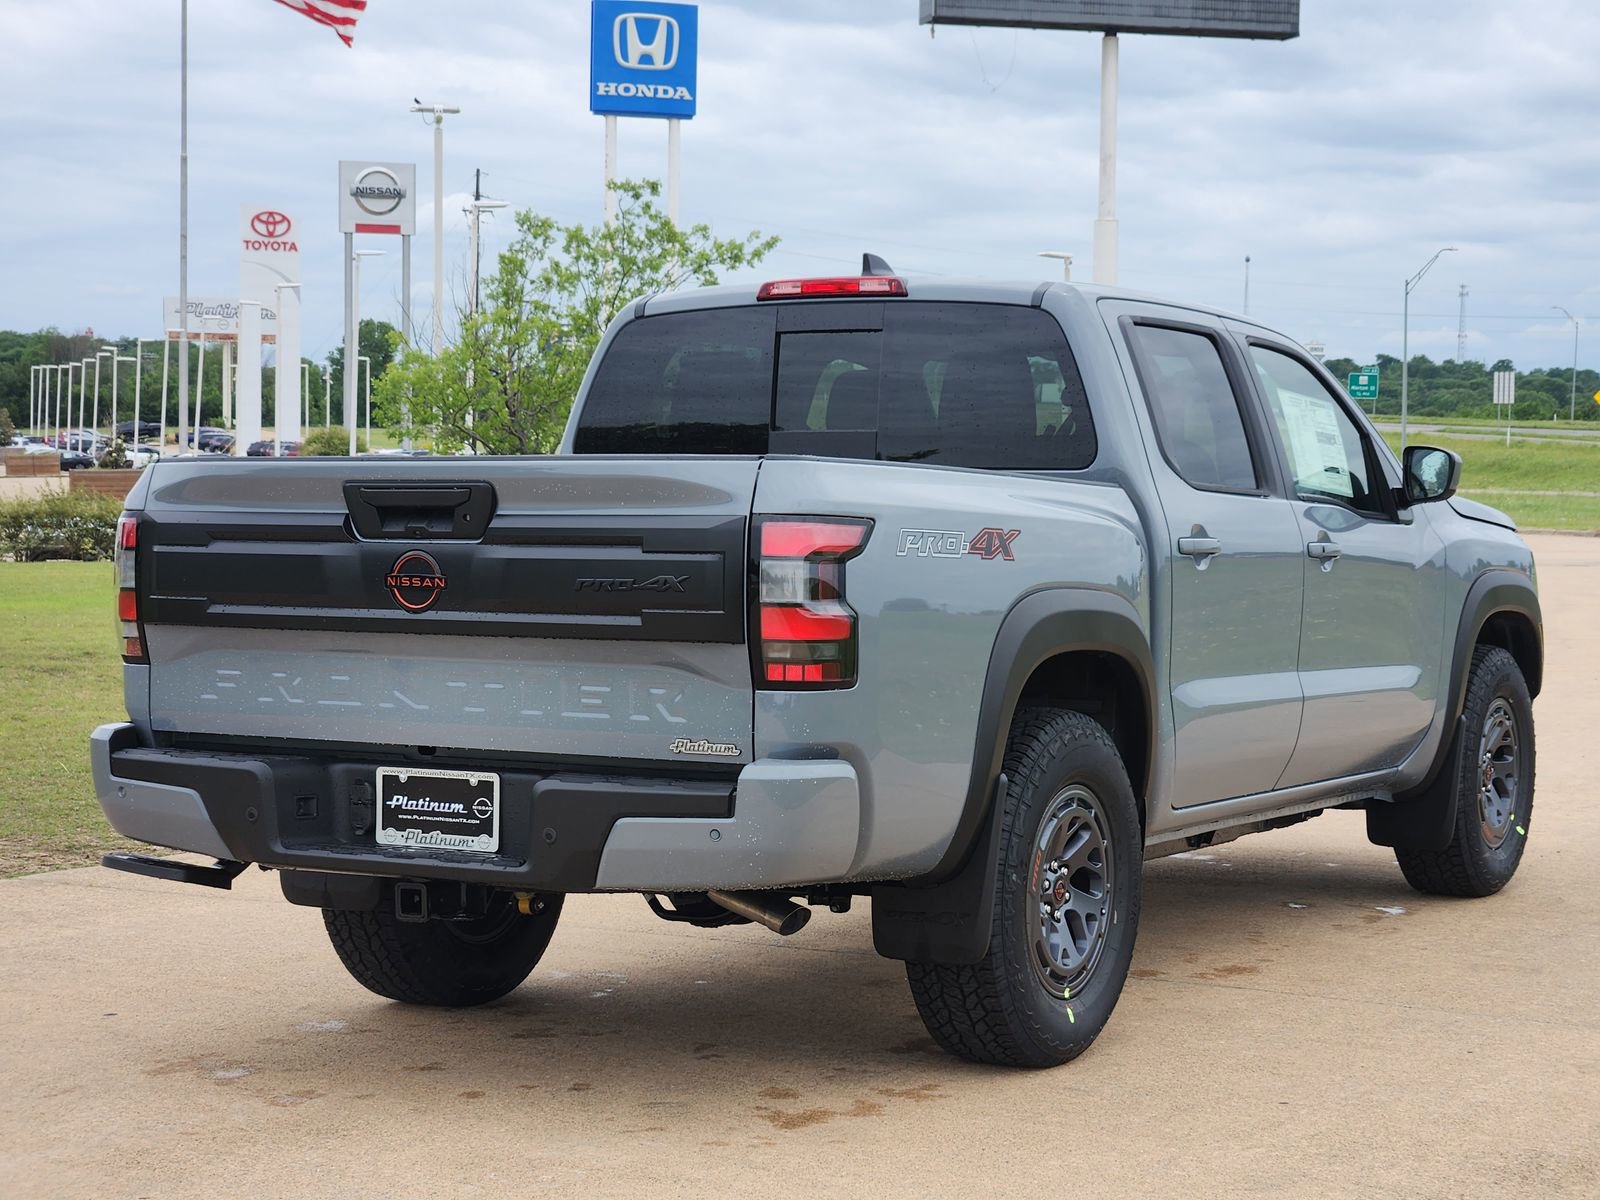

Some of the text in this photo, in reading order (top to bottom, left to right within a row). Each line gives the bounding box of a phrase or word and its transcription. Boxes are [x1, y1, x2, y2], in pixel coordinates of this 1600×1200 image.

[596, 82, 693, 101] HONDA
[355, 186, 401, 196] NISSAN
[243, 240, 298, 252] TOYOTA
[175, 302, 277, 320] Platinm
[896, 528, 1021, 561] PRO-4X
[387, 575, 445, 588] NISSAN
[575, 575, 691, 592] PRO-4X
[670, 738, 742, 756] Platinum
[382, 769, 494, 780] www.PlatinumNissanTX.com
[386, 795, 468, 813] Platinum
[404, 830, 473, 848] Platinum
